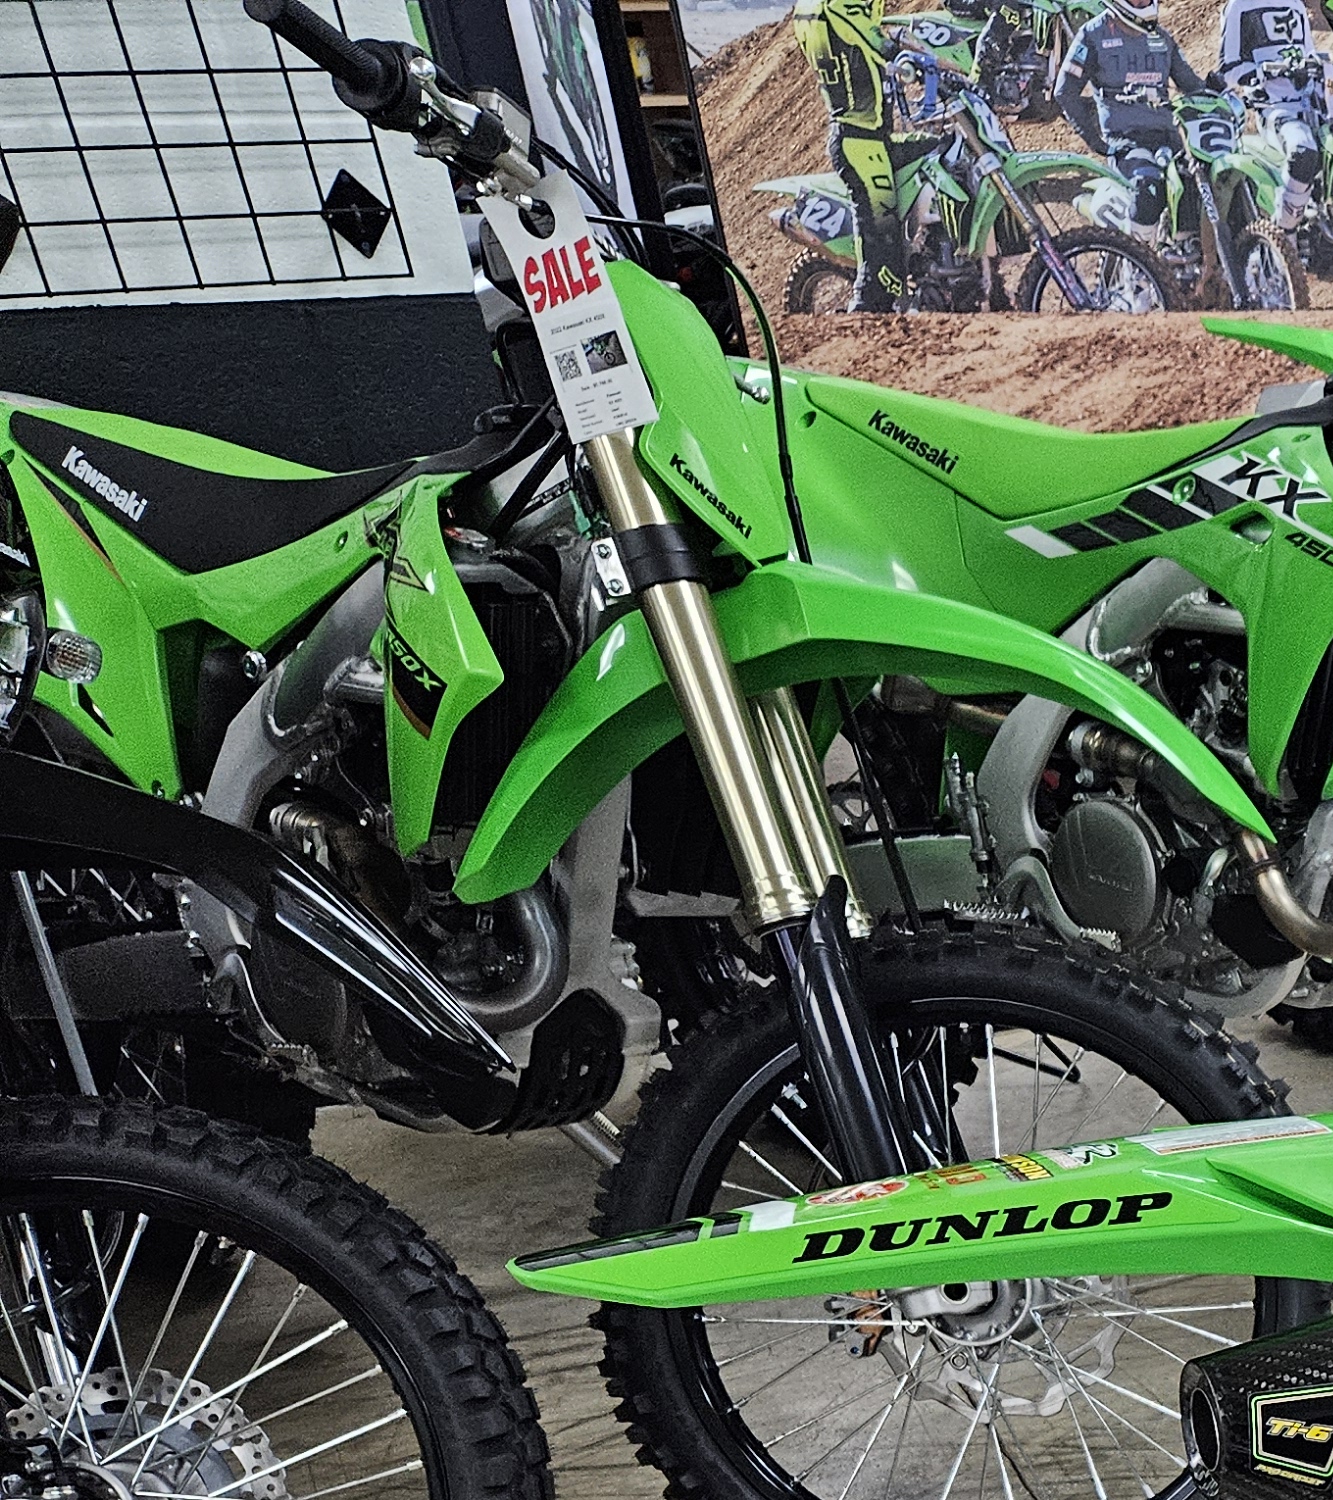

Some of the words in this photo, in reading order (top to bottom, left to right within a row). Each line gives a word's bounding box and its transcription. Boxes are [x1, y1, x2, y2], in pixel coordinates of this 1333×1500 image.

[912, 20, 951, 47] 30
[523, 235, 602, 314] SALE
[868, 408, 959, 477] Kawasaki
[60, 444, 150, 524] Kawasaki
[669, 452, 753, 540] Kawasaki
[1218, 456, 1331, 522] KX
[791, 1192, 1174, 1264] DUNLOP
